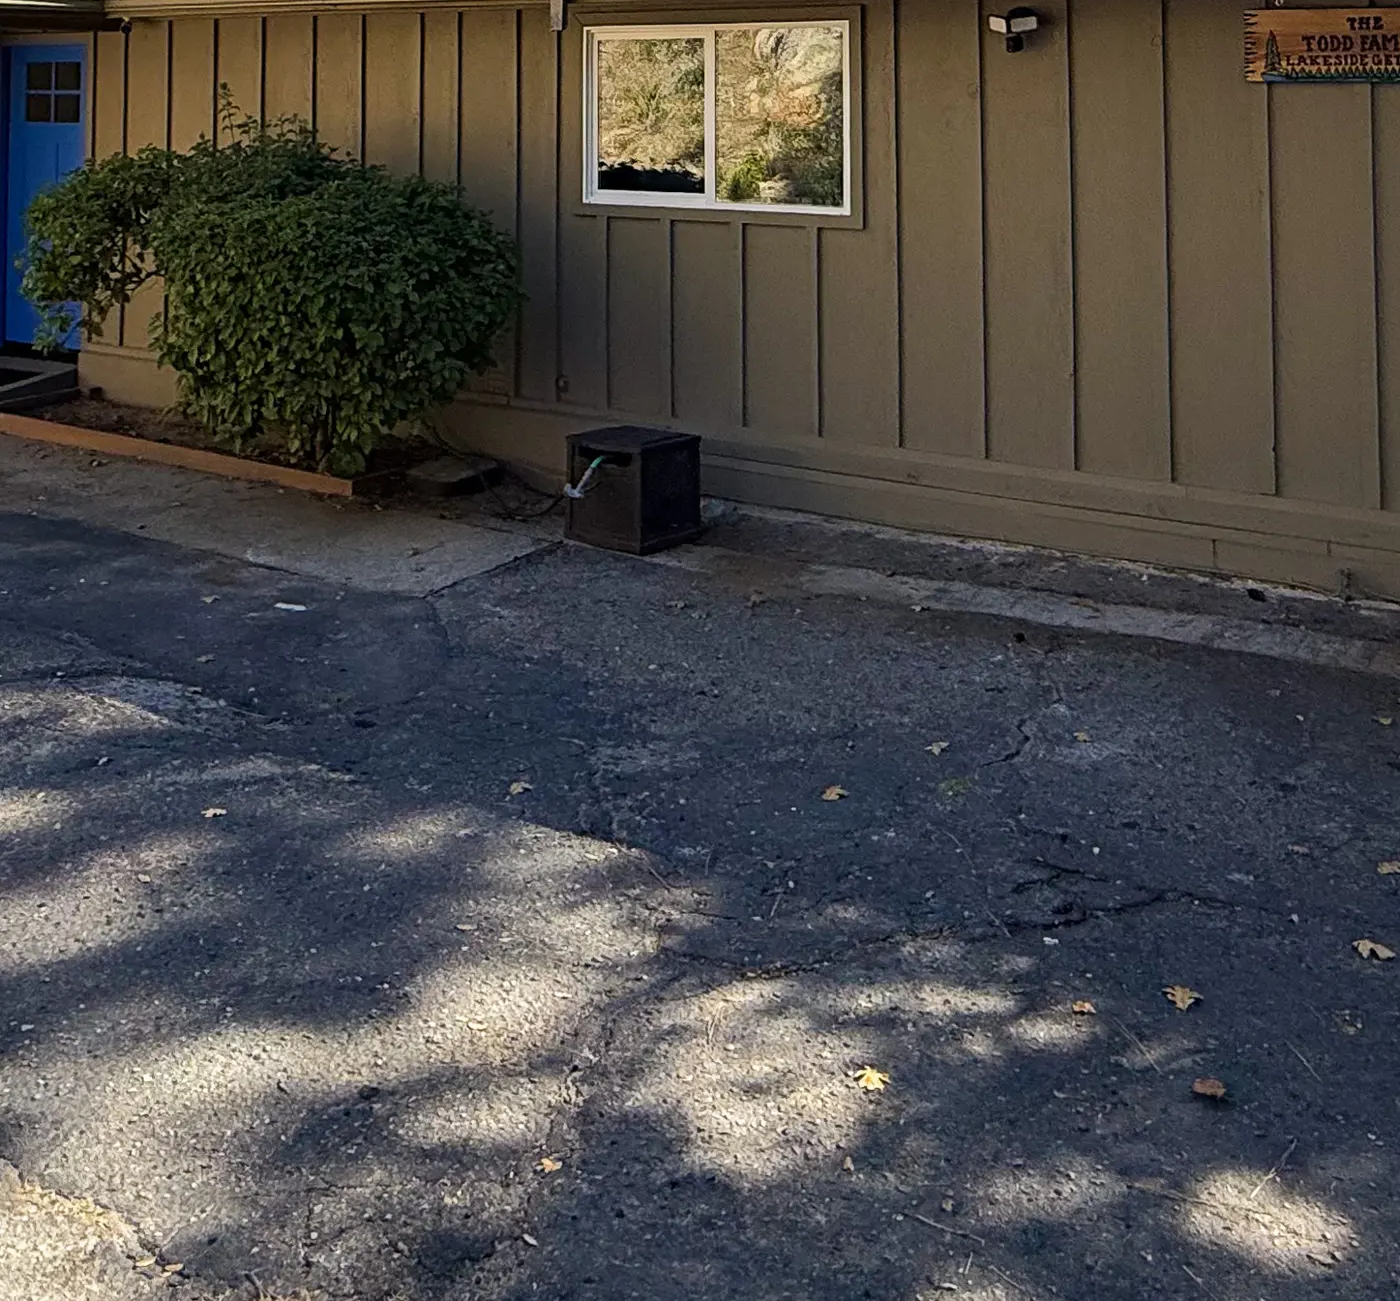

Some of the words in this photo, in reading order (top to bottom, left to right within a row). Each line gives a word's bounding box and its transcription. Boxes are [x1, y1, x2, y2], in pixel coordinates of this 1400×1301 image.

[1346, 16, 1384, 30] THE
[1302, 35, 1354, 52] TODD
[1285, 54, 1369, 66] LAKESIDE
